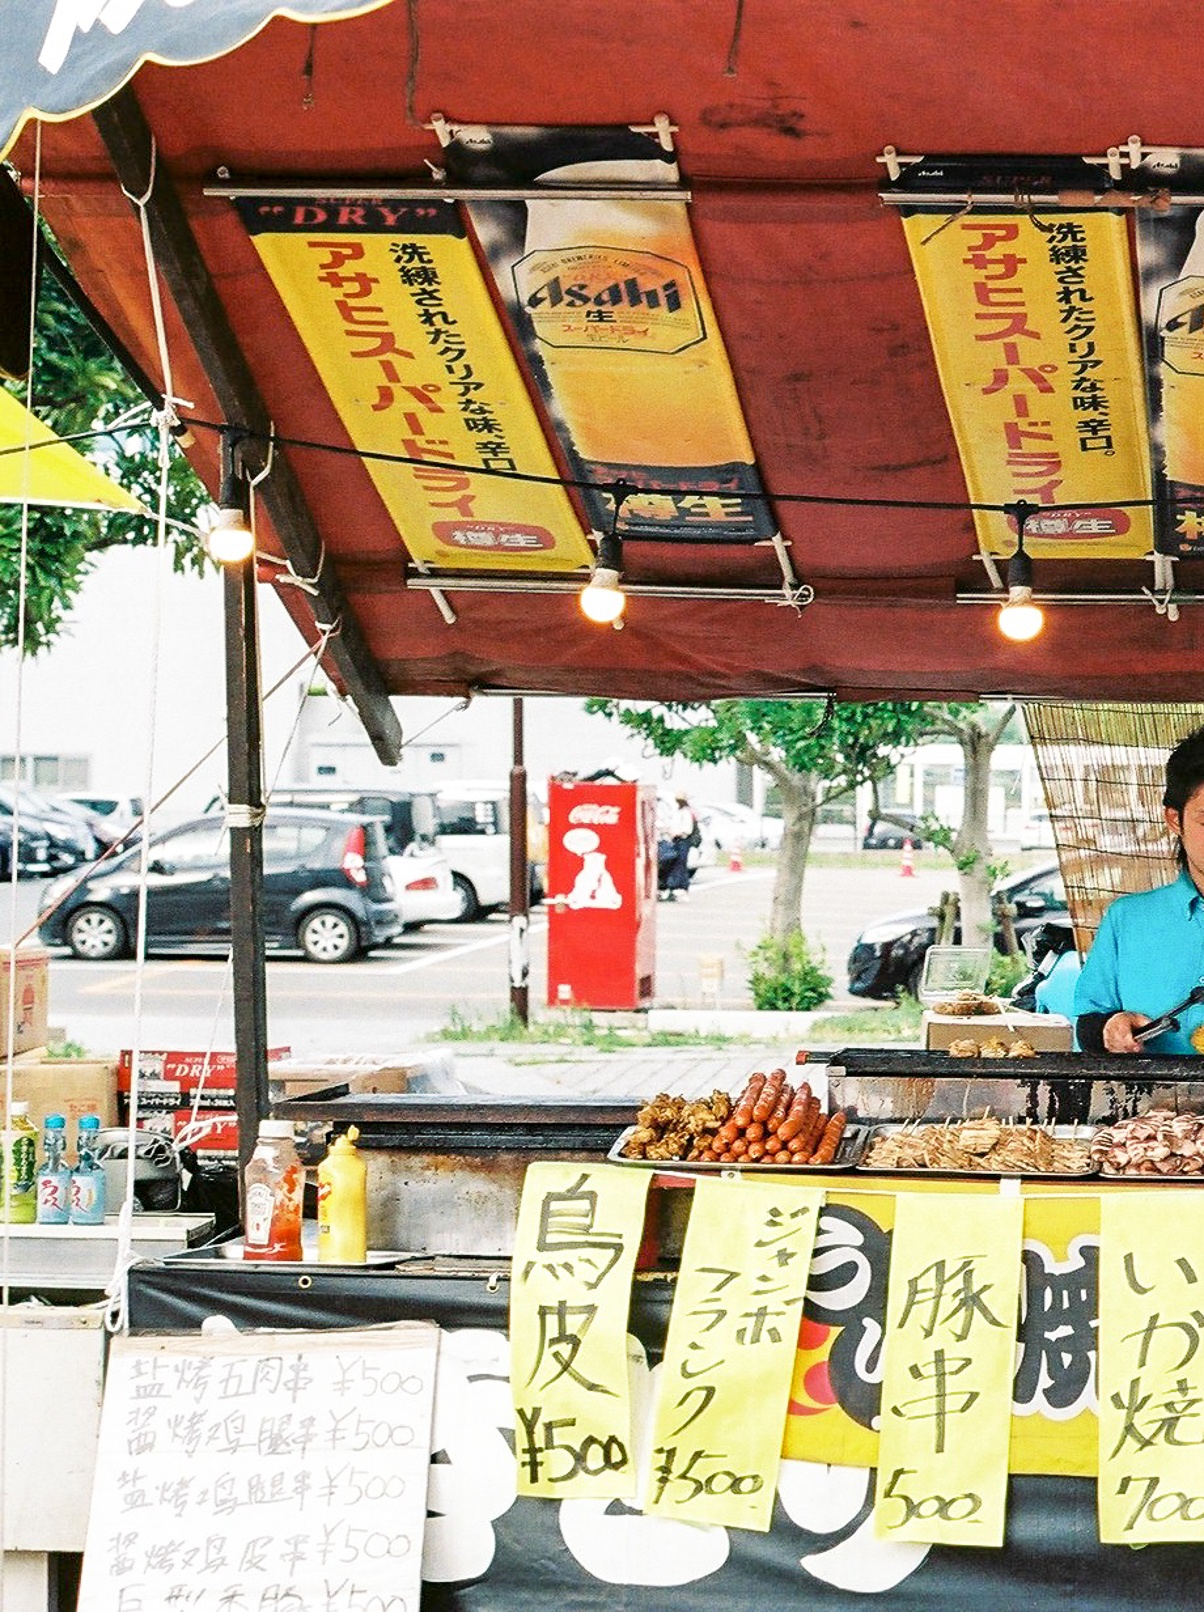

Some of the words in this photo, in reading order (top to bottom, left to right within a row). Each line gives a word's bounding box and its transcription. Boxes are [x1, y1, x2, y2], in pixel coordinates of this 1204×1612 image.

[527, 275, 682, 314] Asahi
[584, 308, 618, 323] 生
[306, 240, 477, 518] アサヒスーパードライ
[960, 222, 1064, 505] アサヒスーパードライ
[521, 1172, 626, 1398] 鳥皮
[735, 1206, 811, 1346] ジャンボ
[331, 1354, 425, 1399] ¥500
[668, 1265, 741, 1438] フランク
[896, 1252, 1012, 1454] 豚串
[324, 1406, 416, 1452] ¥500
[516, 1405, 629, 1485] ¥500
[317, 1461, 407, 1507] ¥500
[315, 1518, 412, 1567] ¥500
